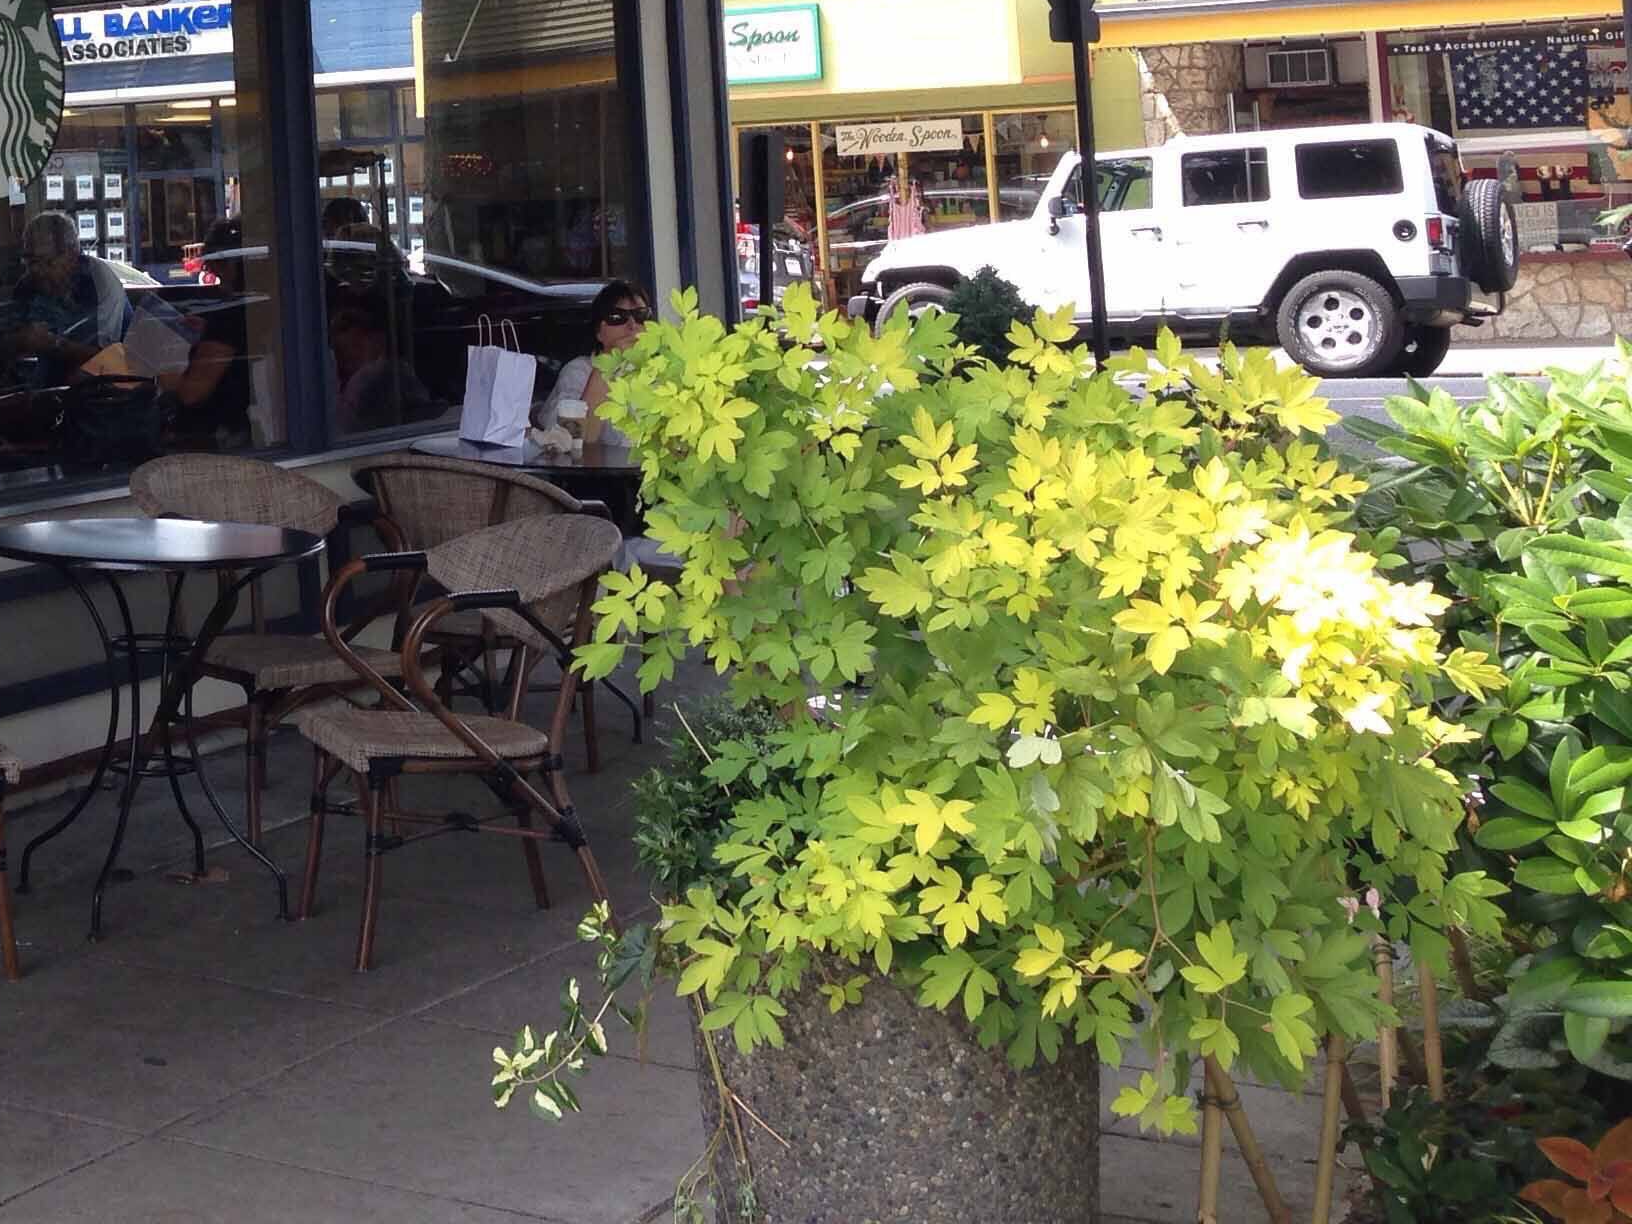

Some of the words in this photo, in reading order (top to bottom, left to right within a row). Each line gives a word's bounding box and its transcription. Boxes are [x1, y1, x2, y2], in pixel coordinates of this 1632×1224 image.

[728, 21, 800, 52] Spoon
[1404, 43, 1430, 52] Teas
[1434, 41, 1442, 51] &
[1445, 39, 1521, 50] Accessories
[1546, 33, 1599, 45] Nautical
[856, 127, 905, 150] Wooden
[910, 125, 952, 149] Spoon
